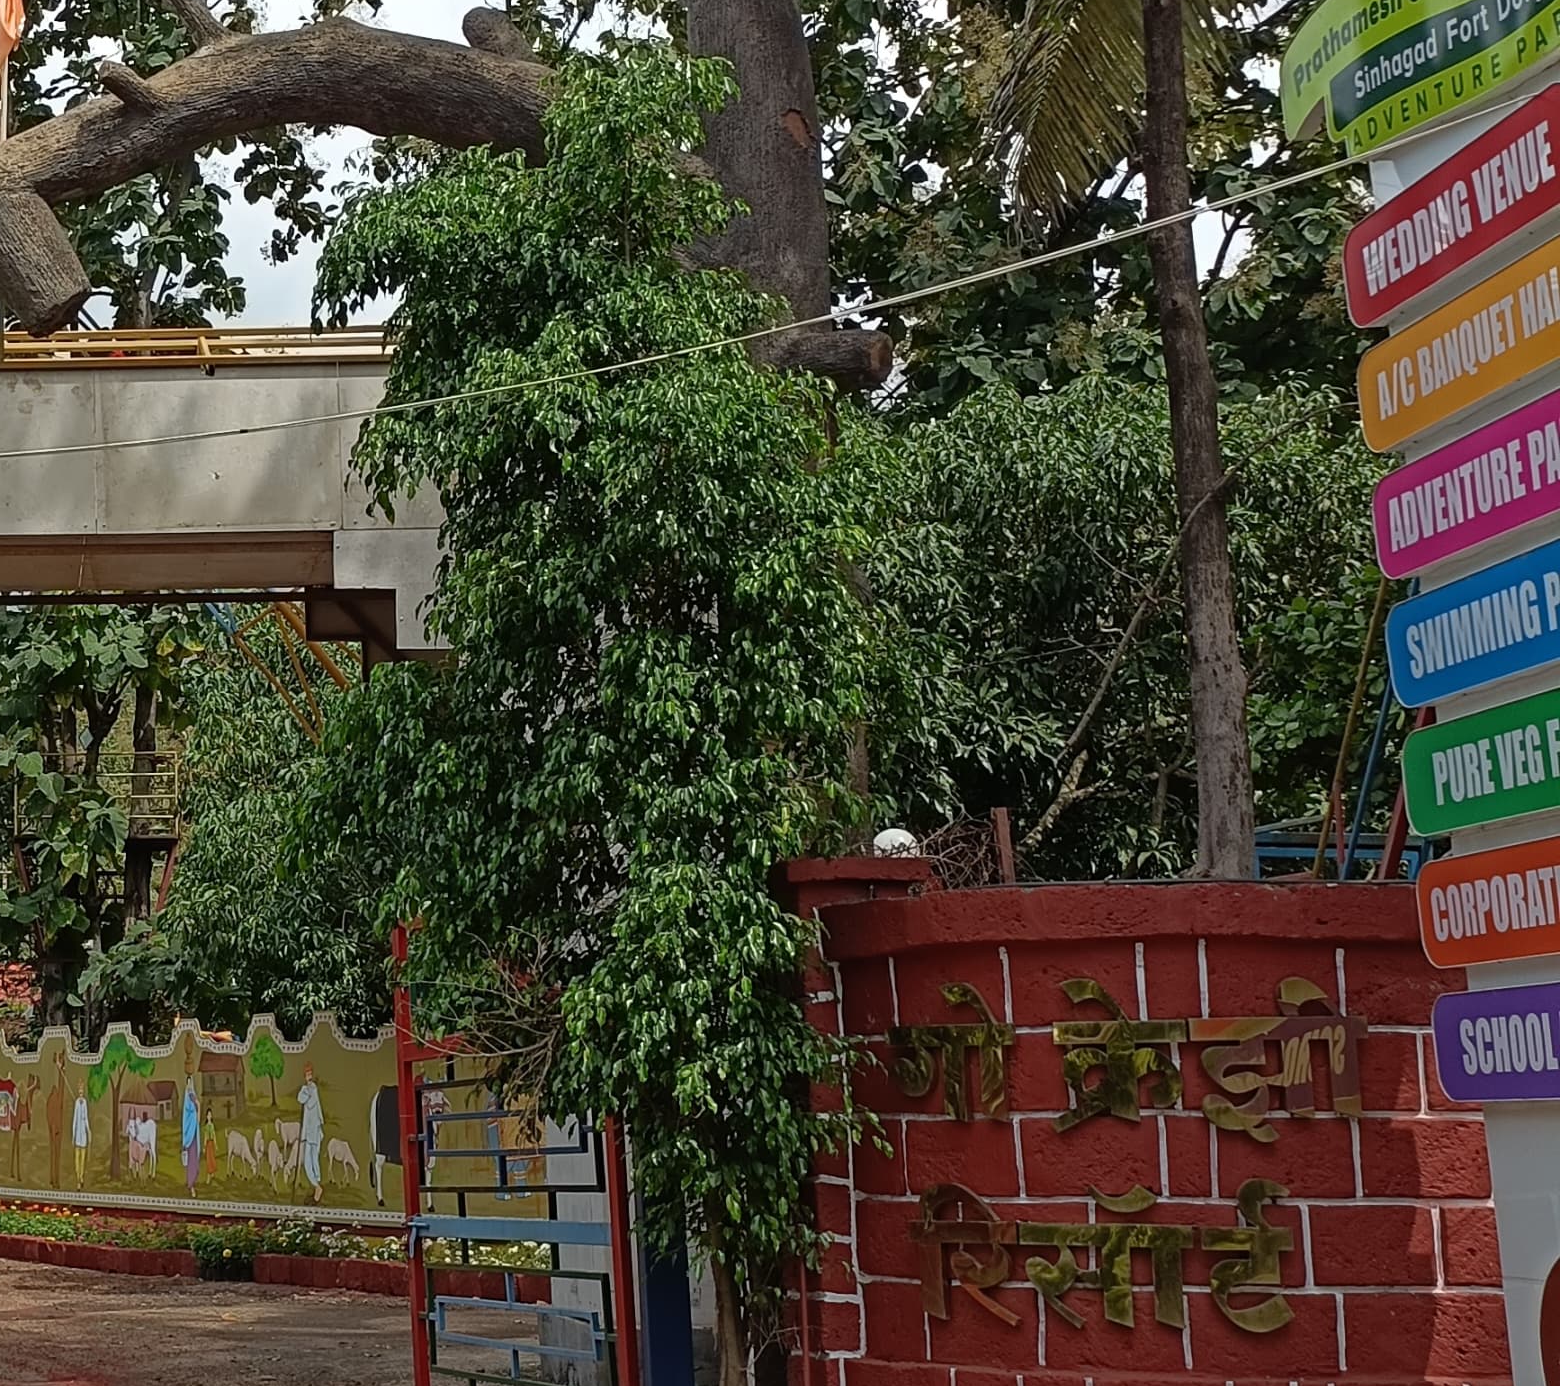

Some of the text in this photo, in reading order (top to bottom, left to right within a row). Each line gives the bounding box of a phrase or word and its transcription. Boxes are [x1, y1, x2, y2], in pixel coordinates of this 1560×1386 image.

[1352, 53, 1502, 150] ADVENTURE
[1354, 28, 1438, 99] Sinhagad
[1445, 4, 1490, 50] Fort
[1362, 121, 1556, 297] WEDDING VENUE
[1376, 350, 1416, 421] A/C
[1416, 294, 1516, 397] BANQUET
[1388, 419, 1560, 553] ADVENTURE PA
[1406, 580, 1542, 680] SWIMMING
[1432, 737, 1495, 806] PURE
[1494, 724, 1545, 790] VEG
[886, 981, 1016, 1121] गो
[1460, 1013, 1558, 1075] SCHOOL
